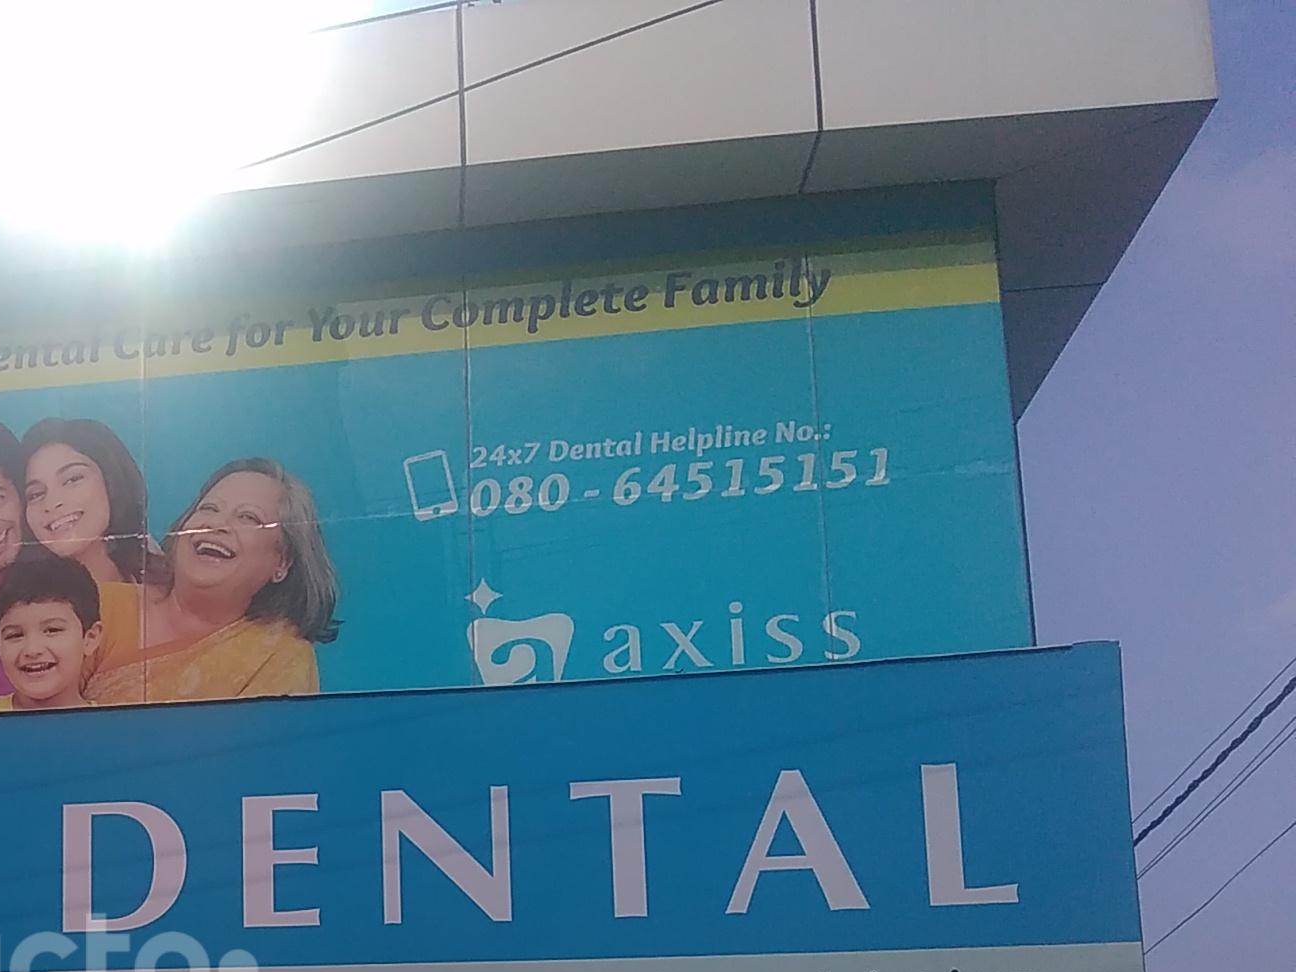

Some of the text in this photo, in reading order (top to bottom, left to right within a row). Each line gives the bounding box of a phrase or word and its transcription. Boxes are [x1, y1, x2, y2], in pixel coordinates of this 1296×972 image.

[113, 320, 214, 361] Care
[225, 311, 295, 357] for
[308, 303, 415, 343] Your
[421, 280, 648, 333] Complete
[661, 256, 833, 310] Family
[469, 440, 540, 469] 24x7
[547, 431, 643, 463] Dental
[649, 424, 767, 459] Helpline
[470, 473, 570, 517] 080
[612, 447, 892, 507] 64515151
[604, 602, 862, 673] axiss
[61, 762, 1020, 933] DENTAL
